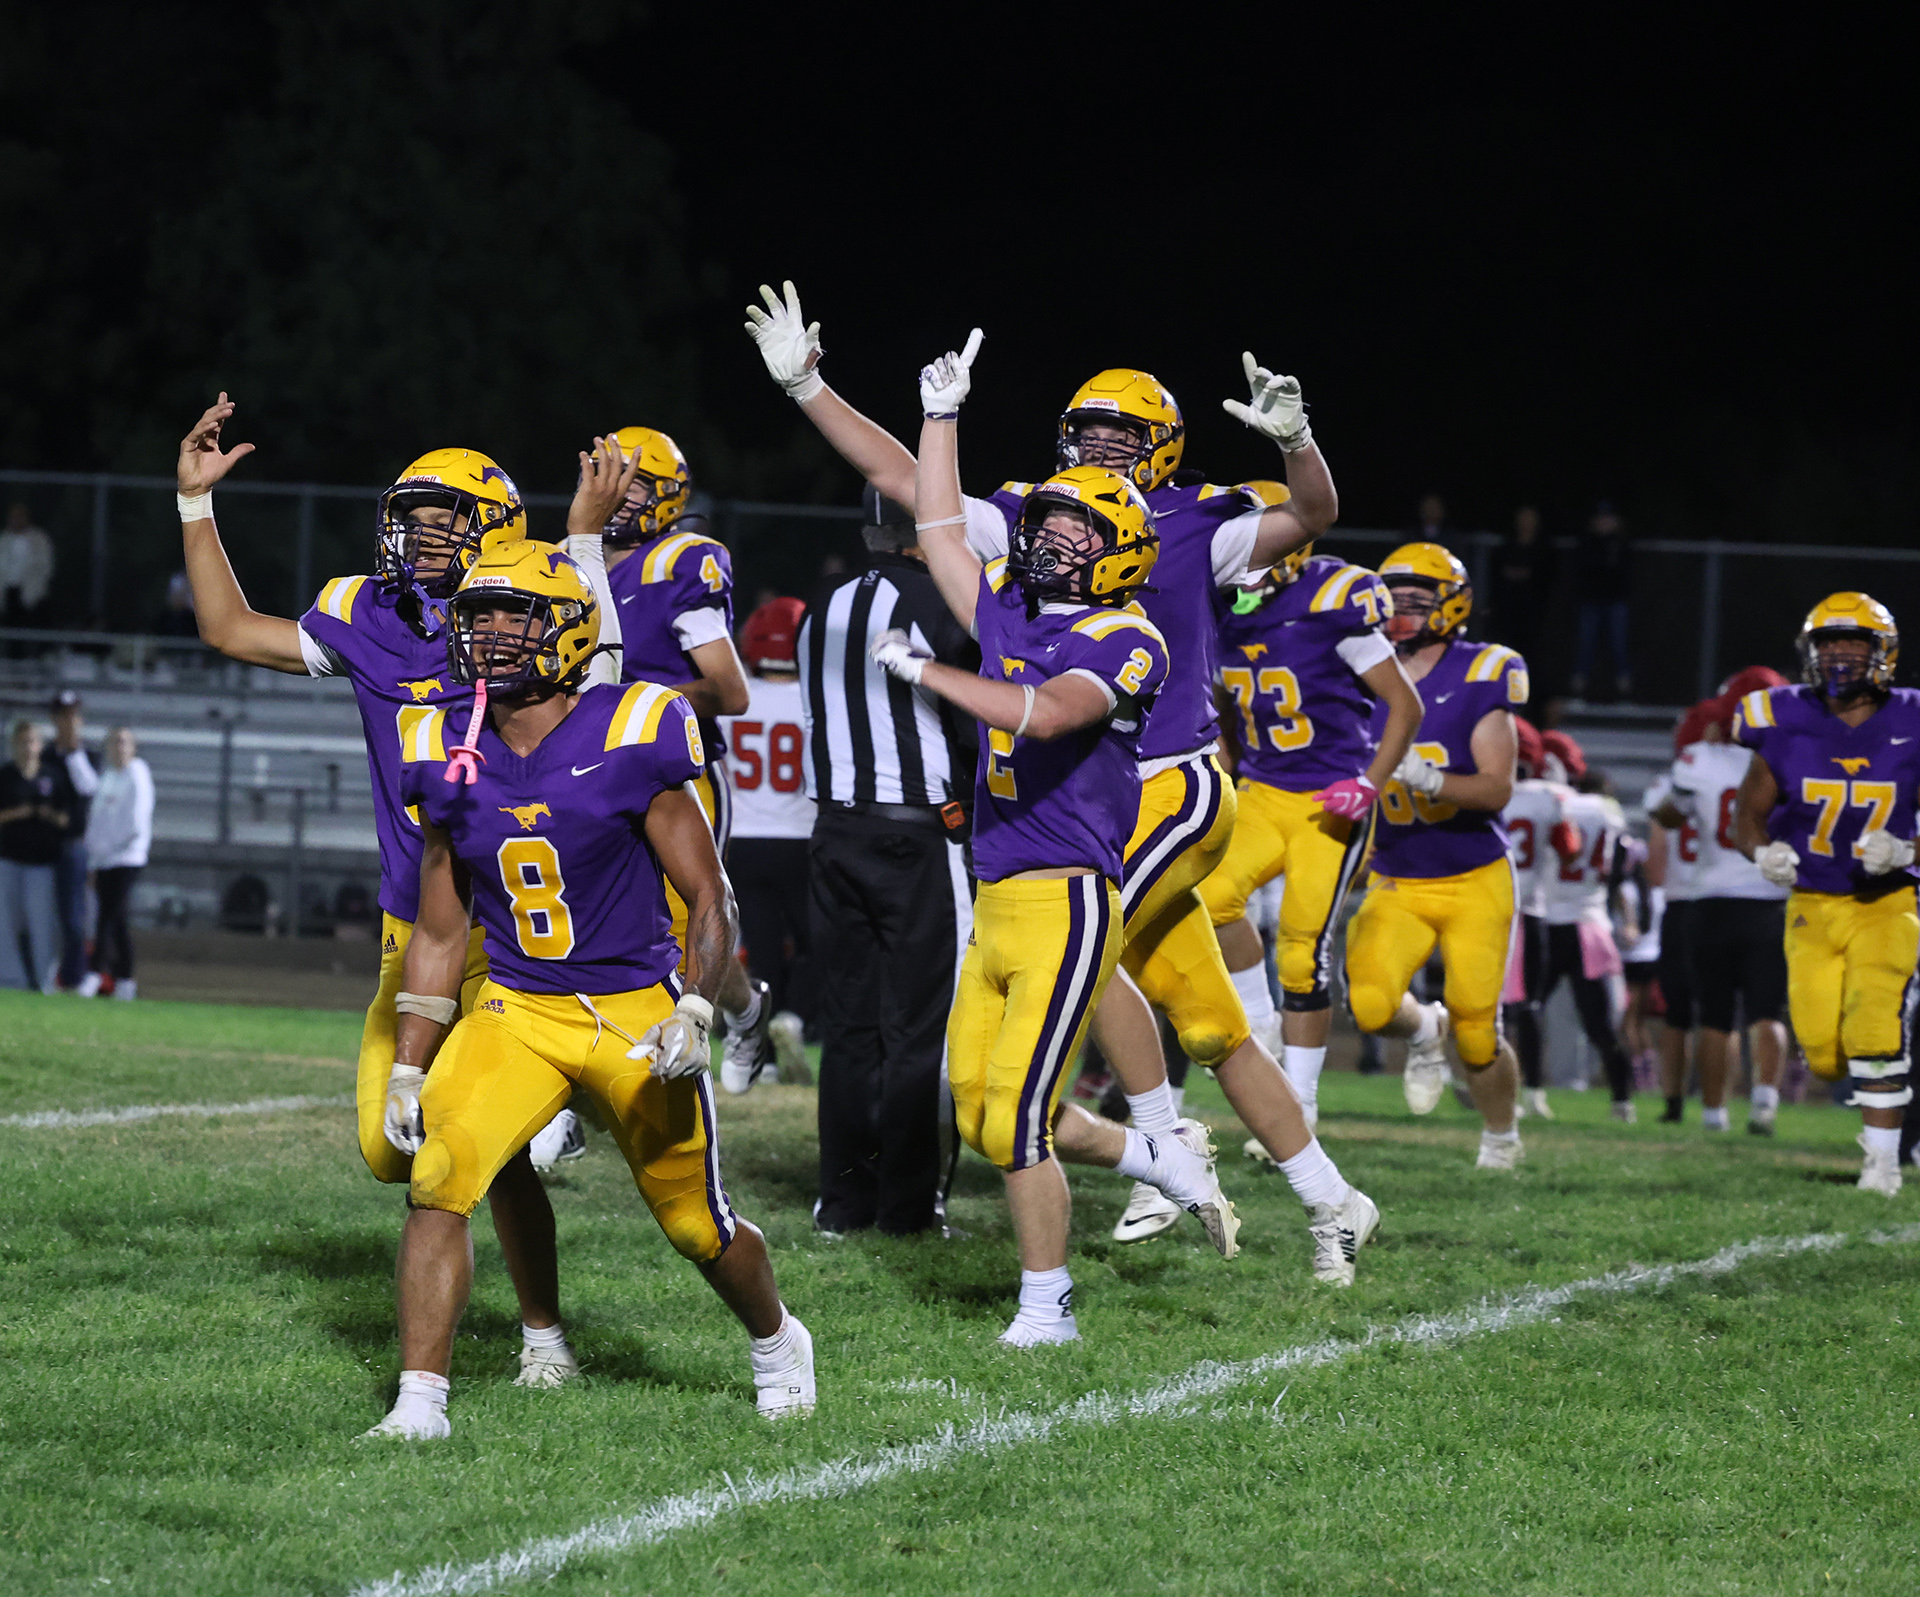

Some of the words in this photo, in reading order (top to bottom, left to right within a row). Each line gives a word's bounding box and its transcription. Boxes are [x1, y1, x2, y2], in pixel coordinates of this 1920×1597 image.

[473, 578, 506, 586] Riddell
[699, 554, 723, 593] 4
[1350, 583, 1394, 626] 73
[1114, 646, 1153, 696] 2
[1220, 665, 1315, 752] 73
[684, 714, 706, 767] 8
[732, 721, 804, 792] 58
[1802, 777, 1897, 859] 77
[496, 836, 576, 961] 8
